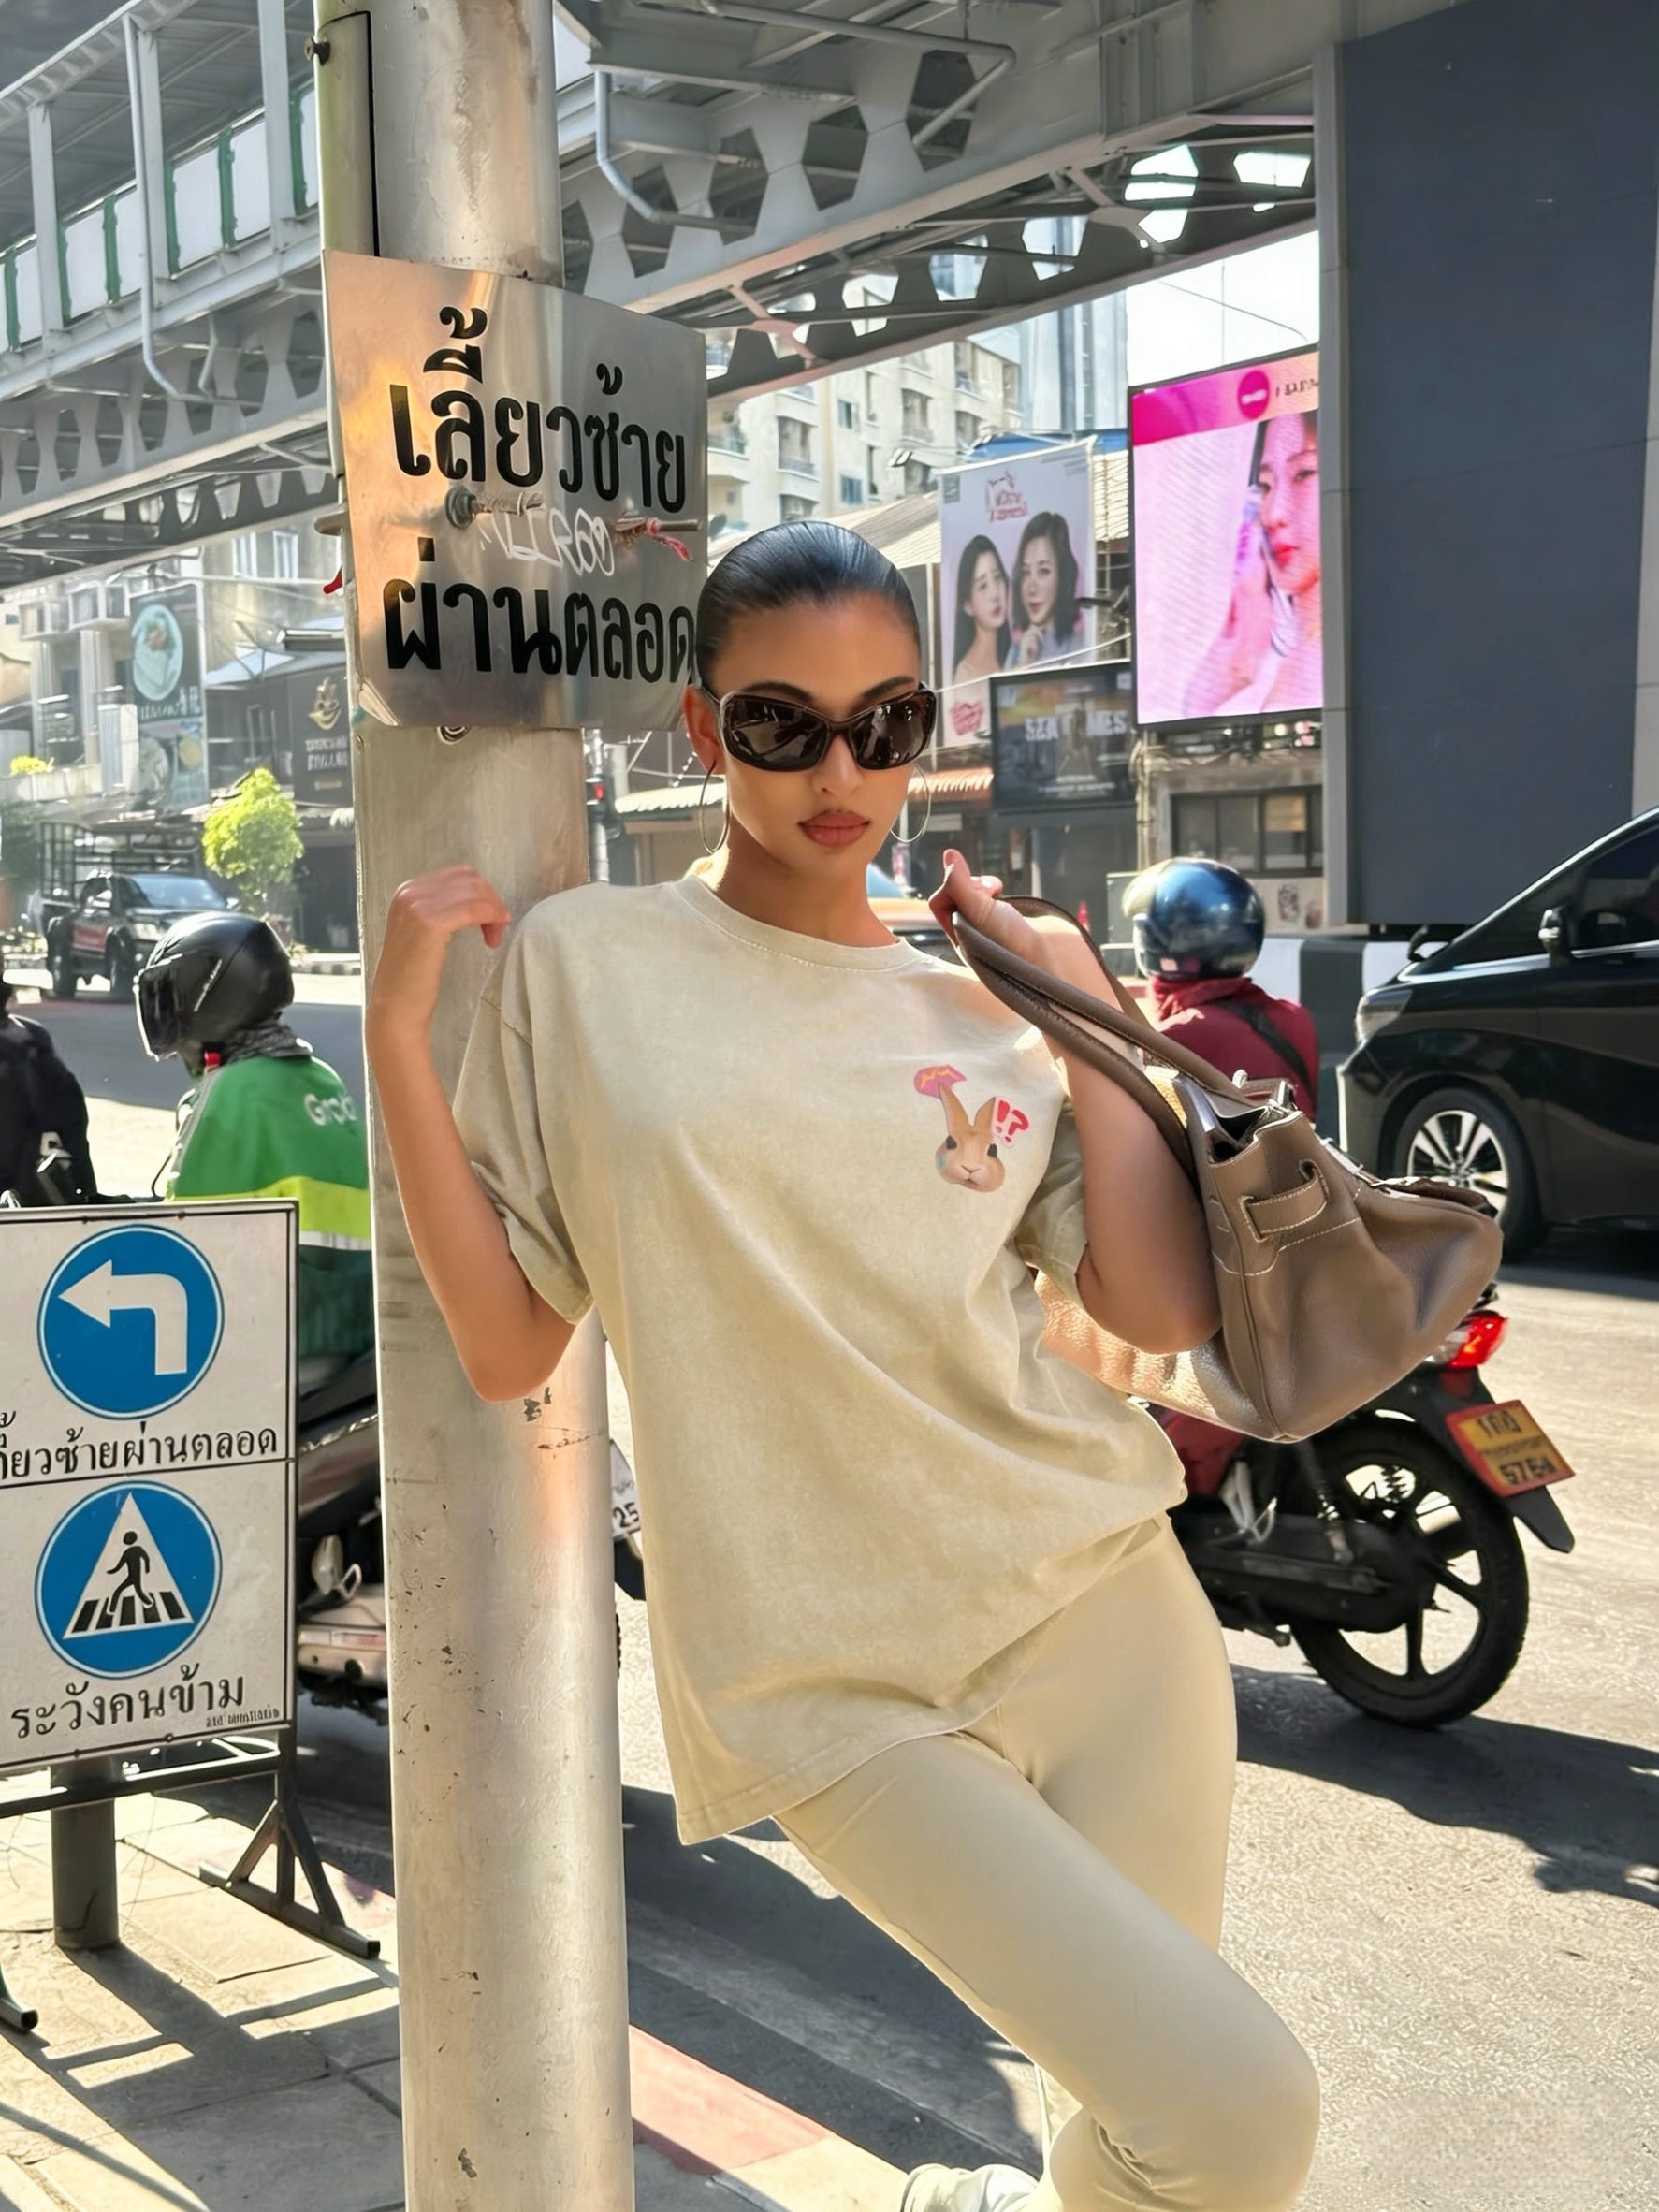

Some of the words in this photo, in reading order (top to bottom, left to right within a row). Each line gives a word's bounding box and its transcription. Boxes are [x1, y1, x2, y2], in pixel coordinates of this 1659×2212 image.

[390, 306, 686, 514] เลี้ยวซ้าย
[383, 537, 694, 683] ผ่านตลอด
[0, 1410, 278, 1480] ี้ยวซ้ายผ่านตลอด
[10, 1662, 243, 1739] ระวังคนข้าม
